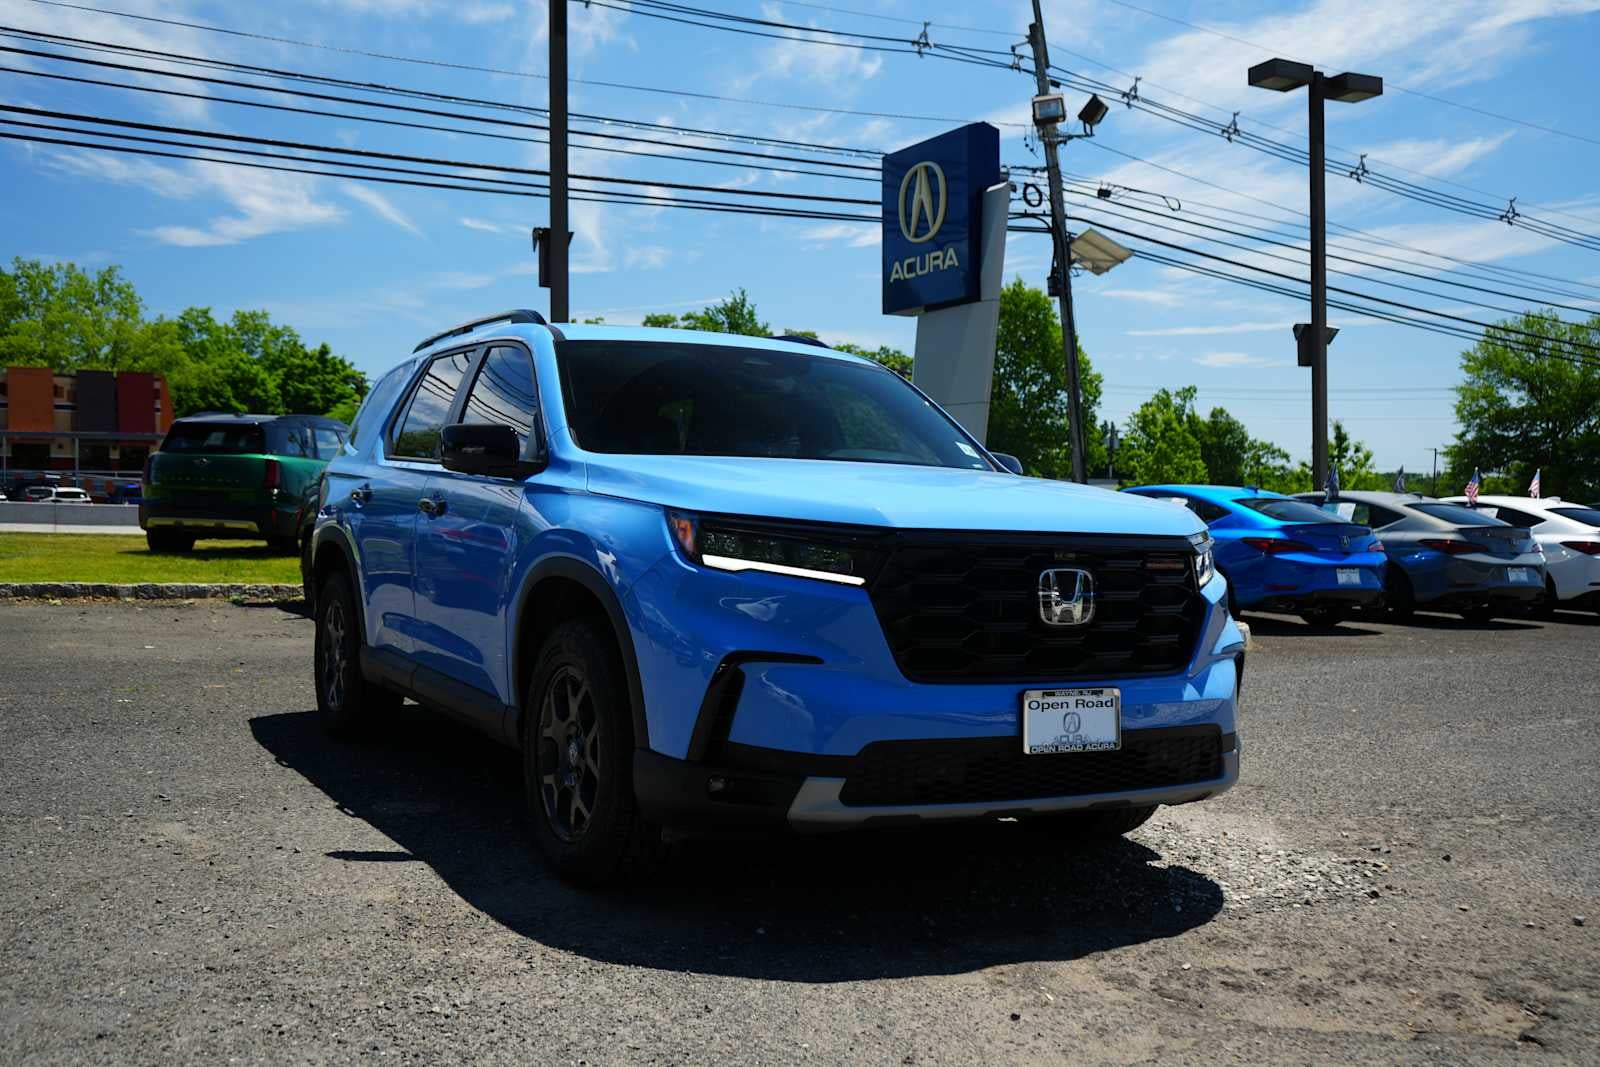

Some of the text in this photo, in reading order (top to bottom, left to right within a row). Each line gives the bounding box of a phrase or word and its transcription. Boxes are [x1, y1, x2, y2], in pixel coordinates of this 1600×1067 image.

[889, 247, 960, 283] ACURA
[1028, 698, 1114, 712] Open Road
